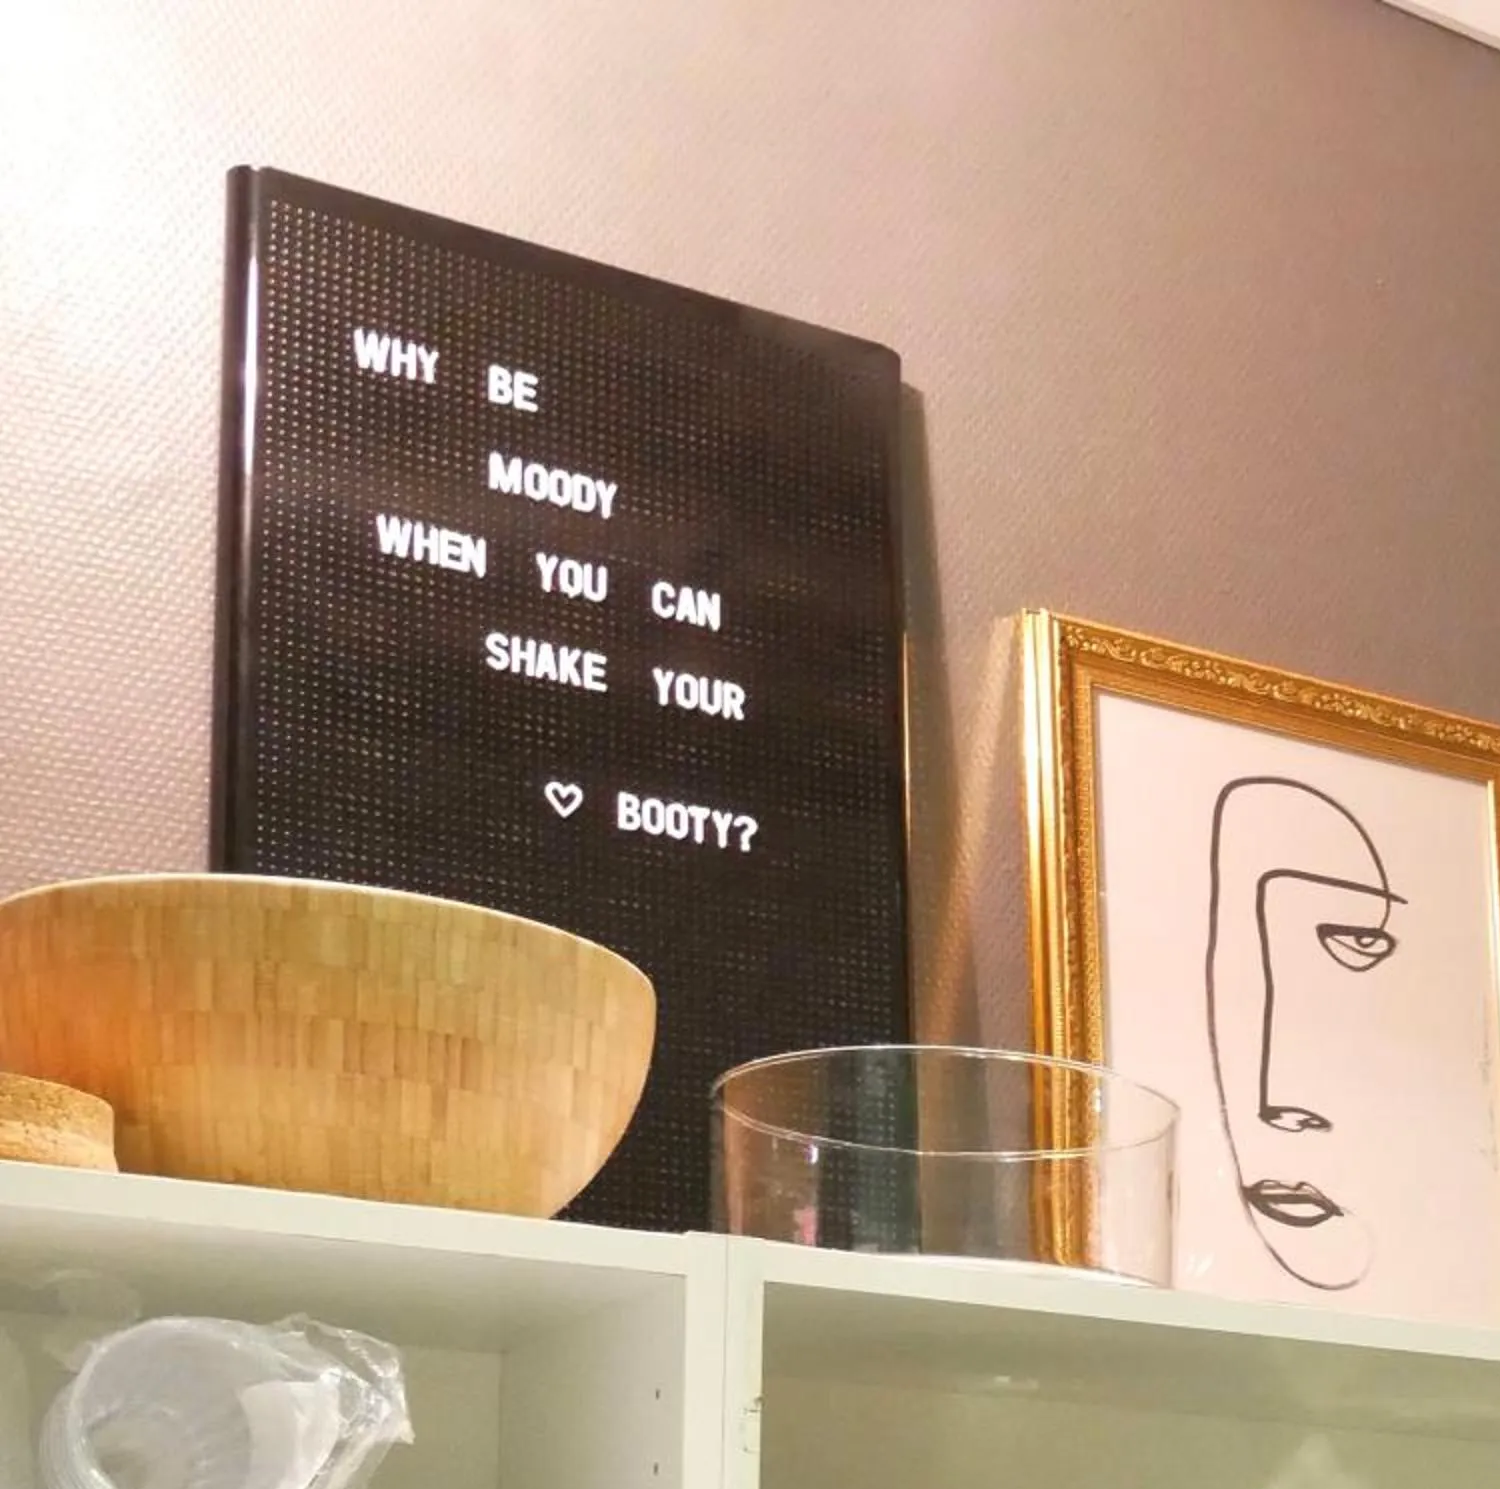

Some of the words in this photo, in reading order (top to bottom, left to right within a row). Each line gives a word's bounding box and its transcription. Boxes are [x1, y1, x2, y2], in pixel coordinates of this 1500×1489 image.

[353, 327, 439, 384] WHY
[488, 364, 539, 413] BE
[488, 452, 618, 519] MOODY
[375, 513, 487, 578] WHEN
[535, 552, 608, 602] YOU
[651, 581, 721, 631] CAN
[485, 632, 607, 692] SHAKE
[652, 667, 746, 721] YOUR
[616, 791, 758, 852] BOOTY?
